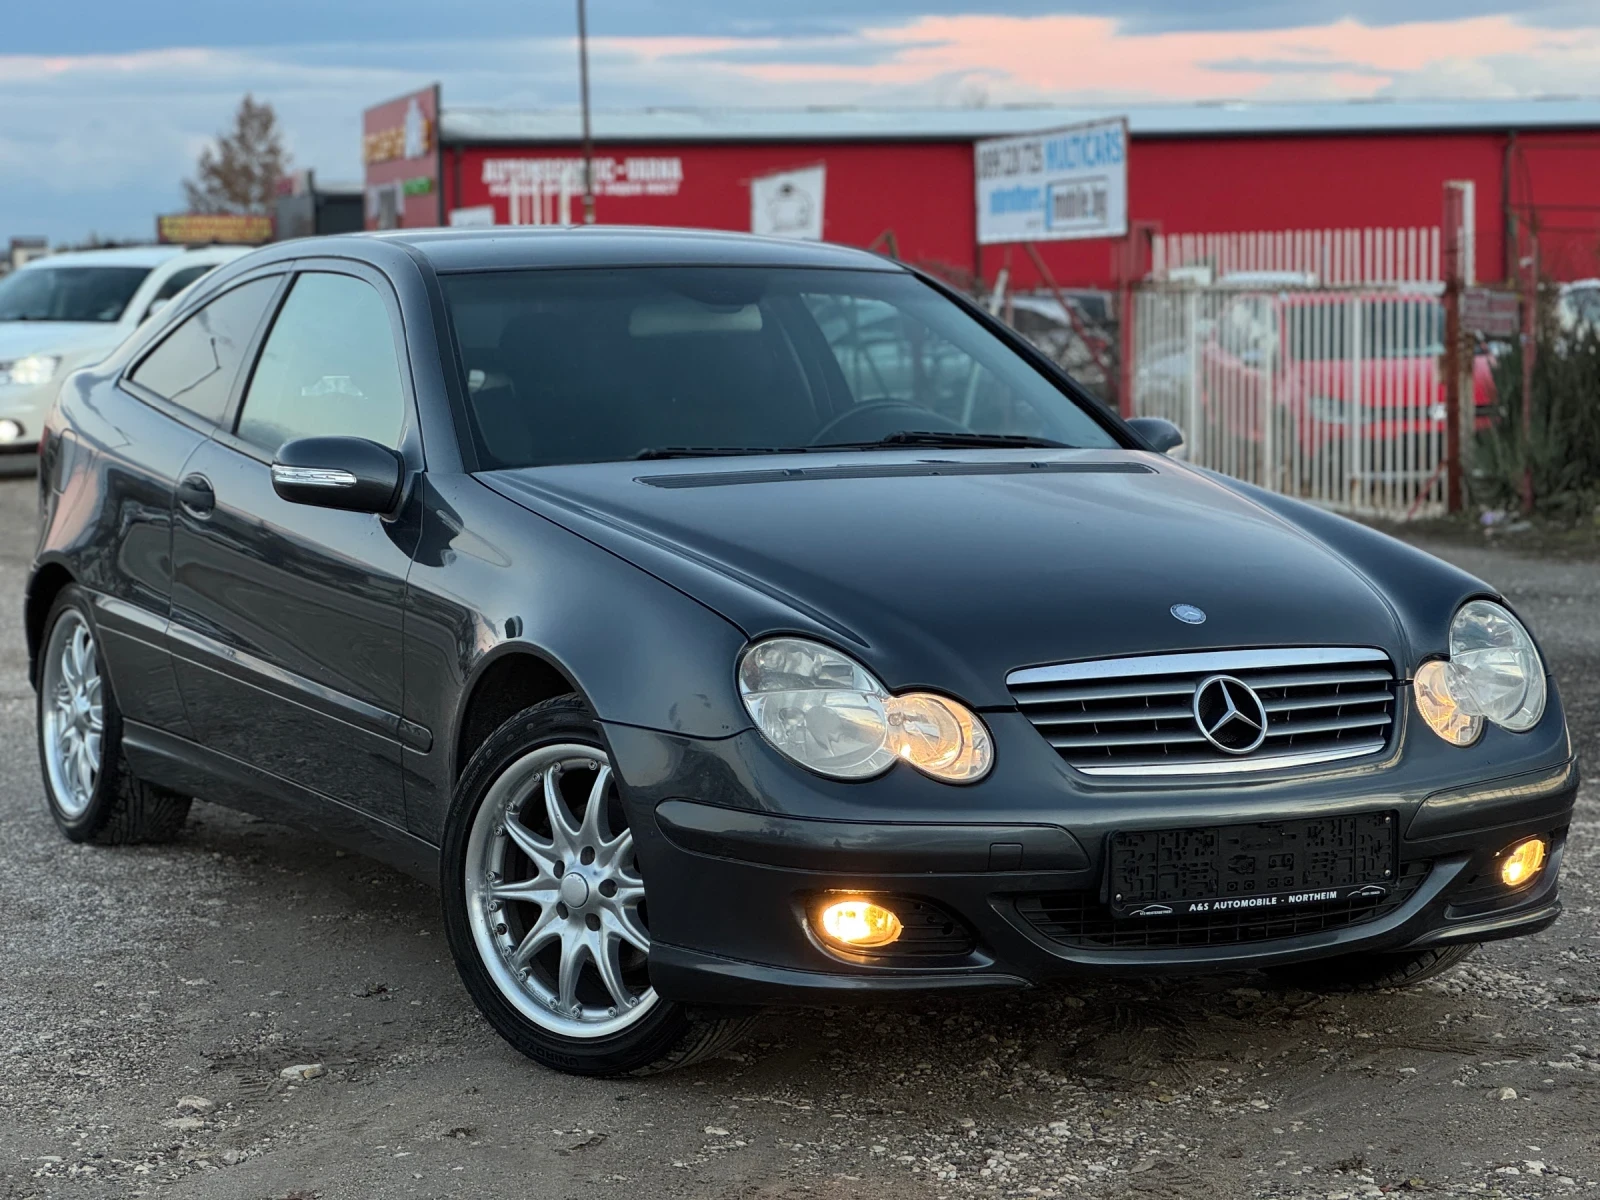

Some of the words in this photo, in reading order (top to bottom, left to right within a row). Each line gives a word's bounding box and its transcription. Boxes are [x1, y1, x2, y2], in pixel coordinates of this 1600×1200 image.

[1188, 902, 1210, 912] A&S
[1213, 897, 1278, 910] AUTOMOBILE
[1288, 890, 1338, 904] NORTHEIM
